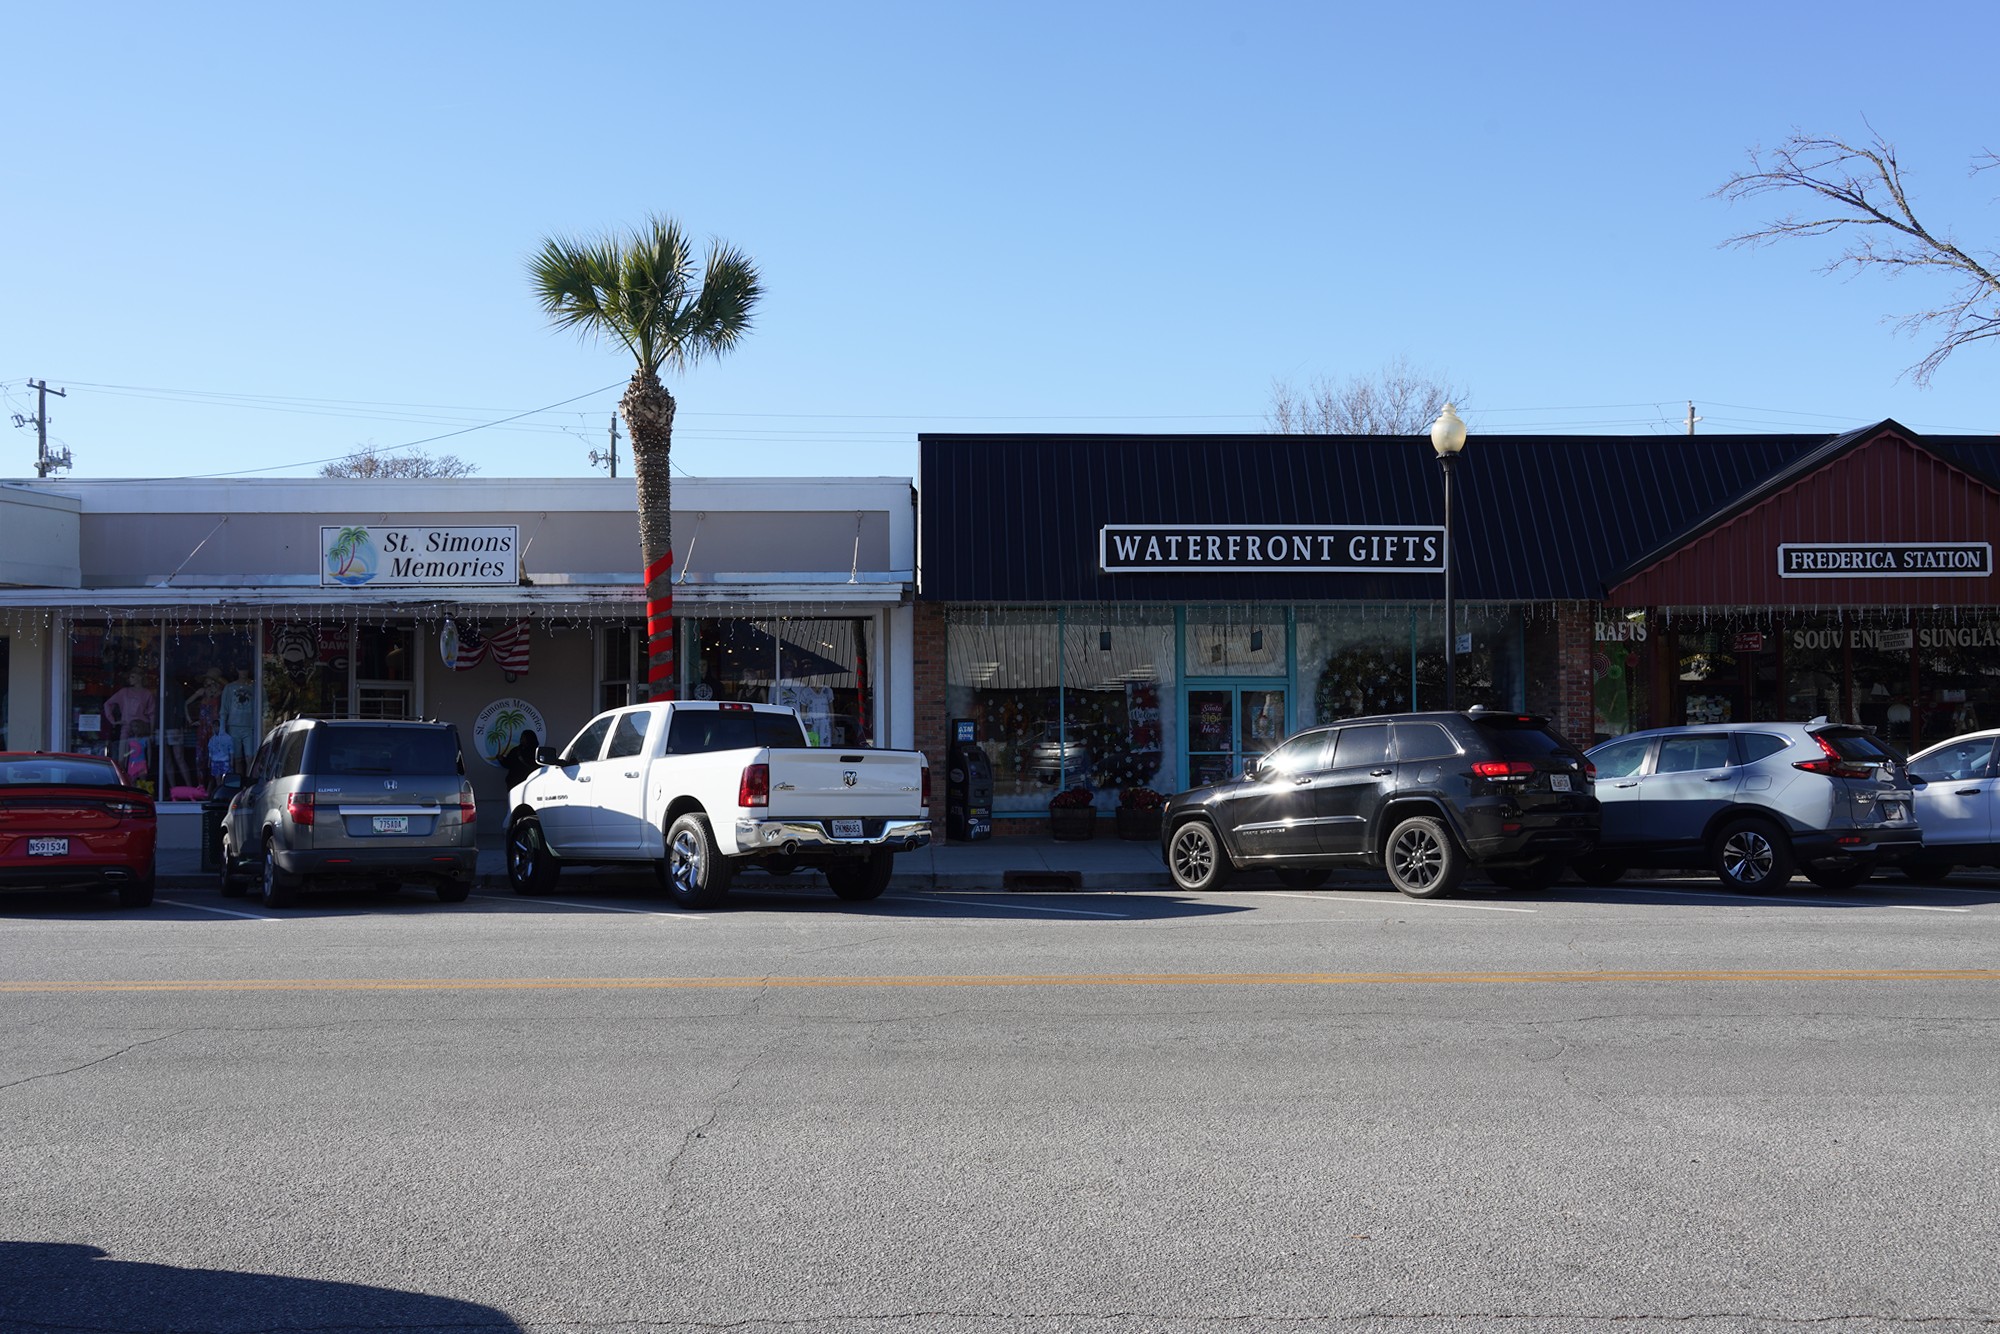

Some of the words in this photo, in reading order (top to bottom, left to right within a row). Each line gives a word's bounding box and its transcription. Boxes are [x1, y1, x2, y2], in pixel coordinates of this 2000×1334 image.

[383, 532, 415, 553] St.
[425, 532, 511, 553] Simons
[1113, 535, 1334, 561] WATERFRONT
[1348, 535, 1437, 562] GIFTS
[389, 557, 505, 577] Memories
[1790, 551, 1897, 570] FREDERICA
[1903, 551, 1981, 569] STATION
[480, 700, 510, 721] Simons
[513, 699, 543, 732] Memories
[1202, 704, 1222, 712] Santa
[1202, 725, 1220, 733] Here
[30, 842, 67, 851] N591534
